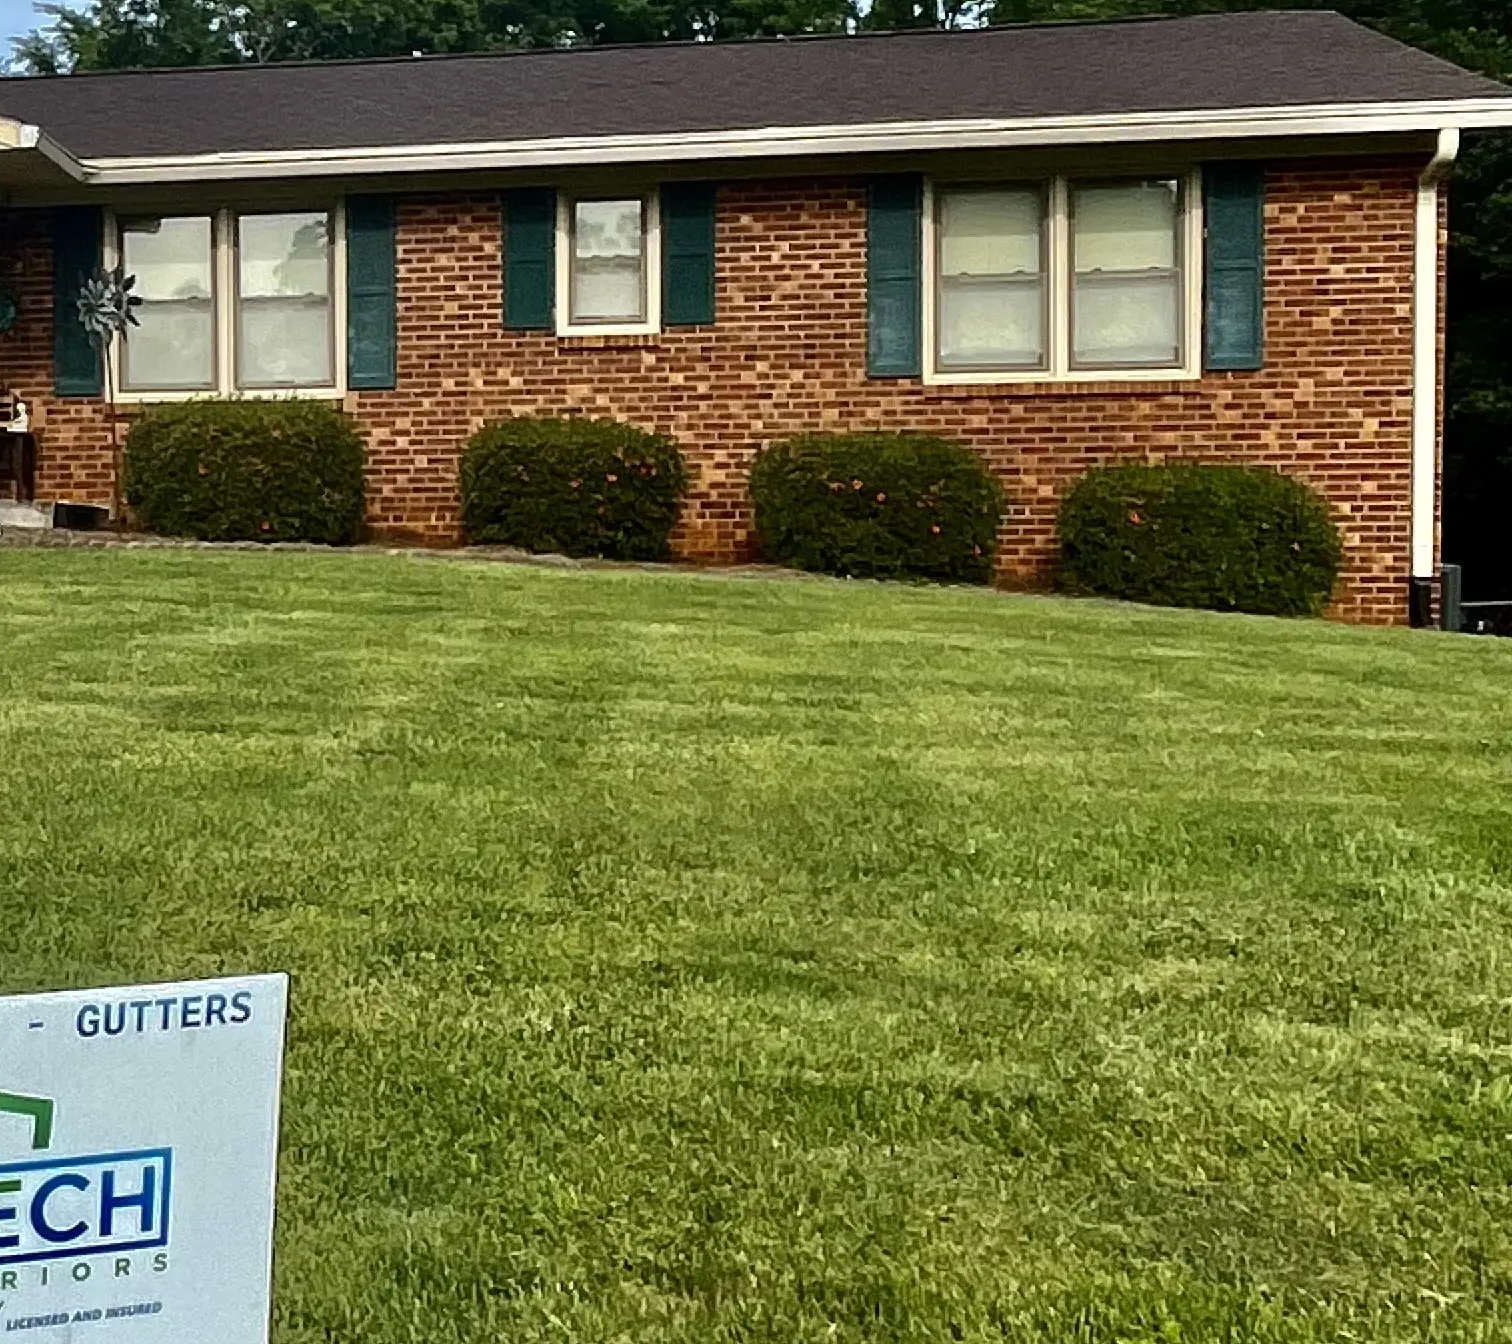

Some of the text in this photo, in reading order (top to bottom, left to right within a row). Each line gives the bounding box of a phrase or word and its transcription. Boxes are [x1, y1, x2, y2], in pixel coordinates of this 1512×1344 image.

[28, 1022, 45, 1030] -
[76, 991, 253, 1038] GUTTERS
[6, 1312, 70, 1331] LICENSED
[71, 1308, 103, 1323] AND
